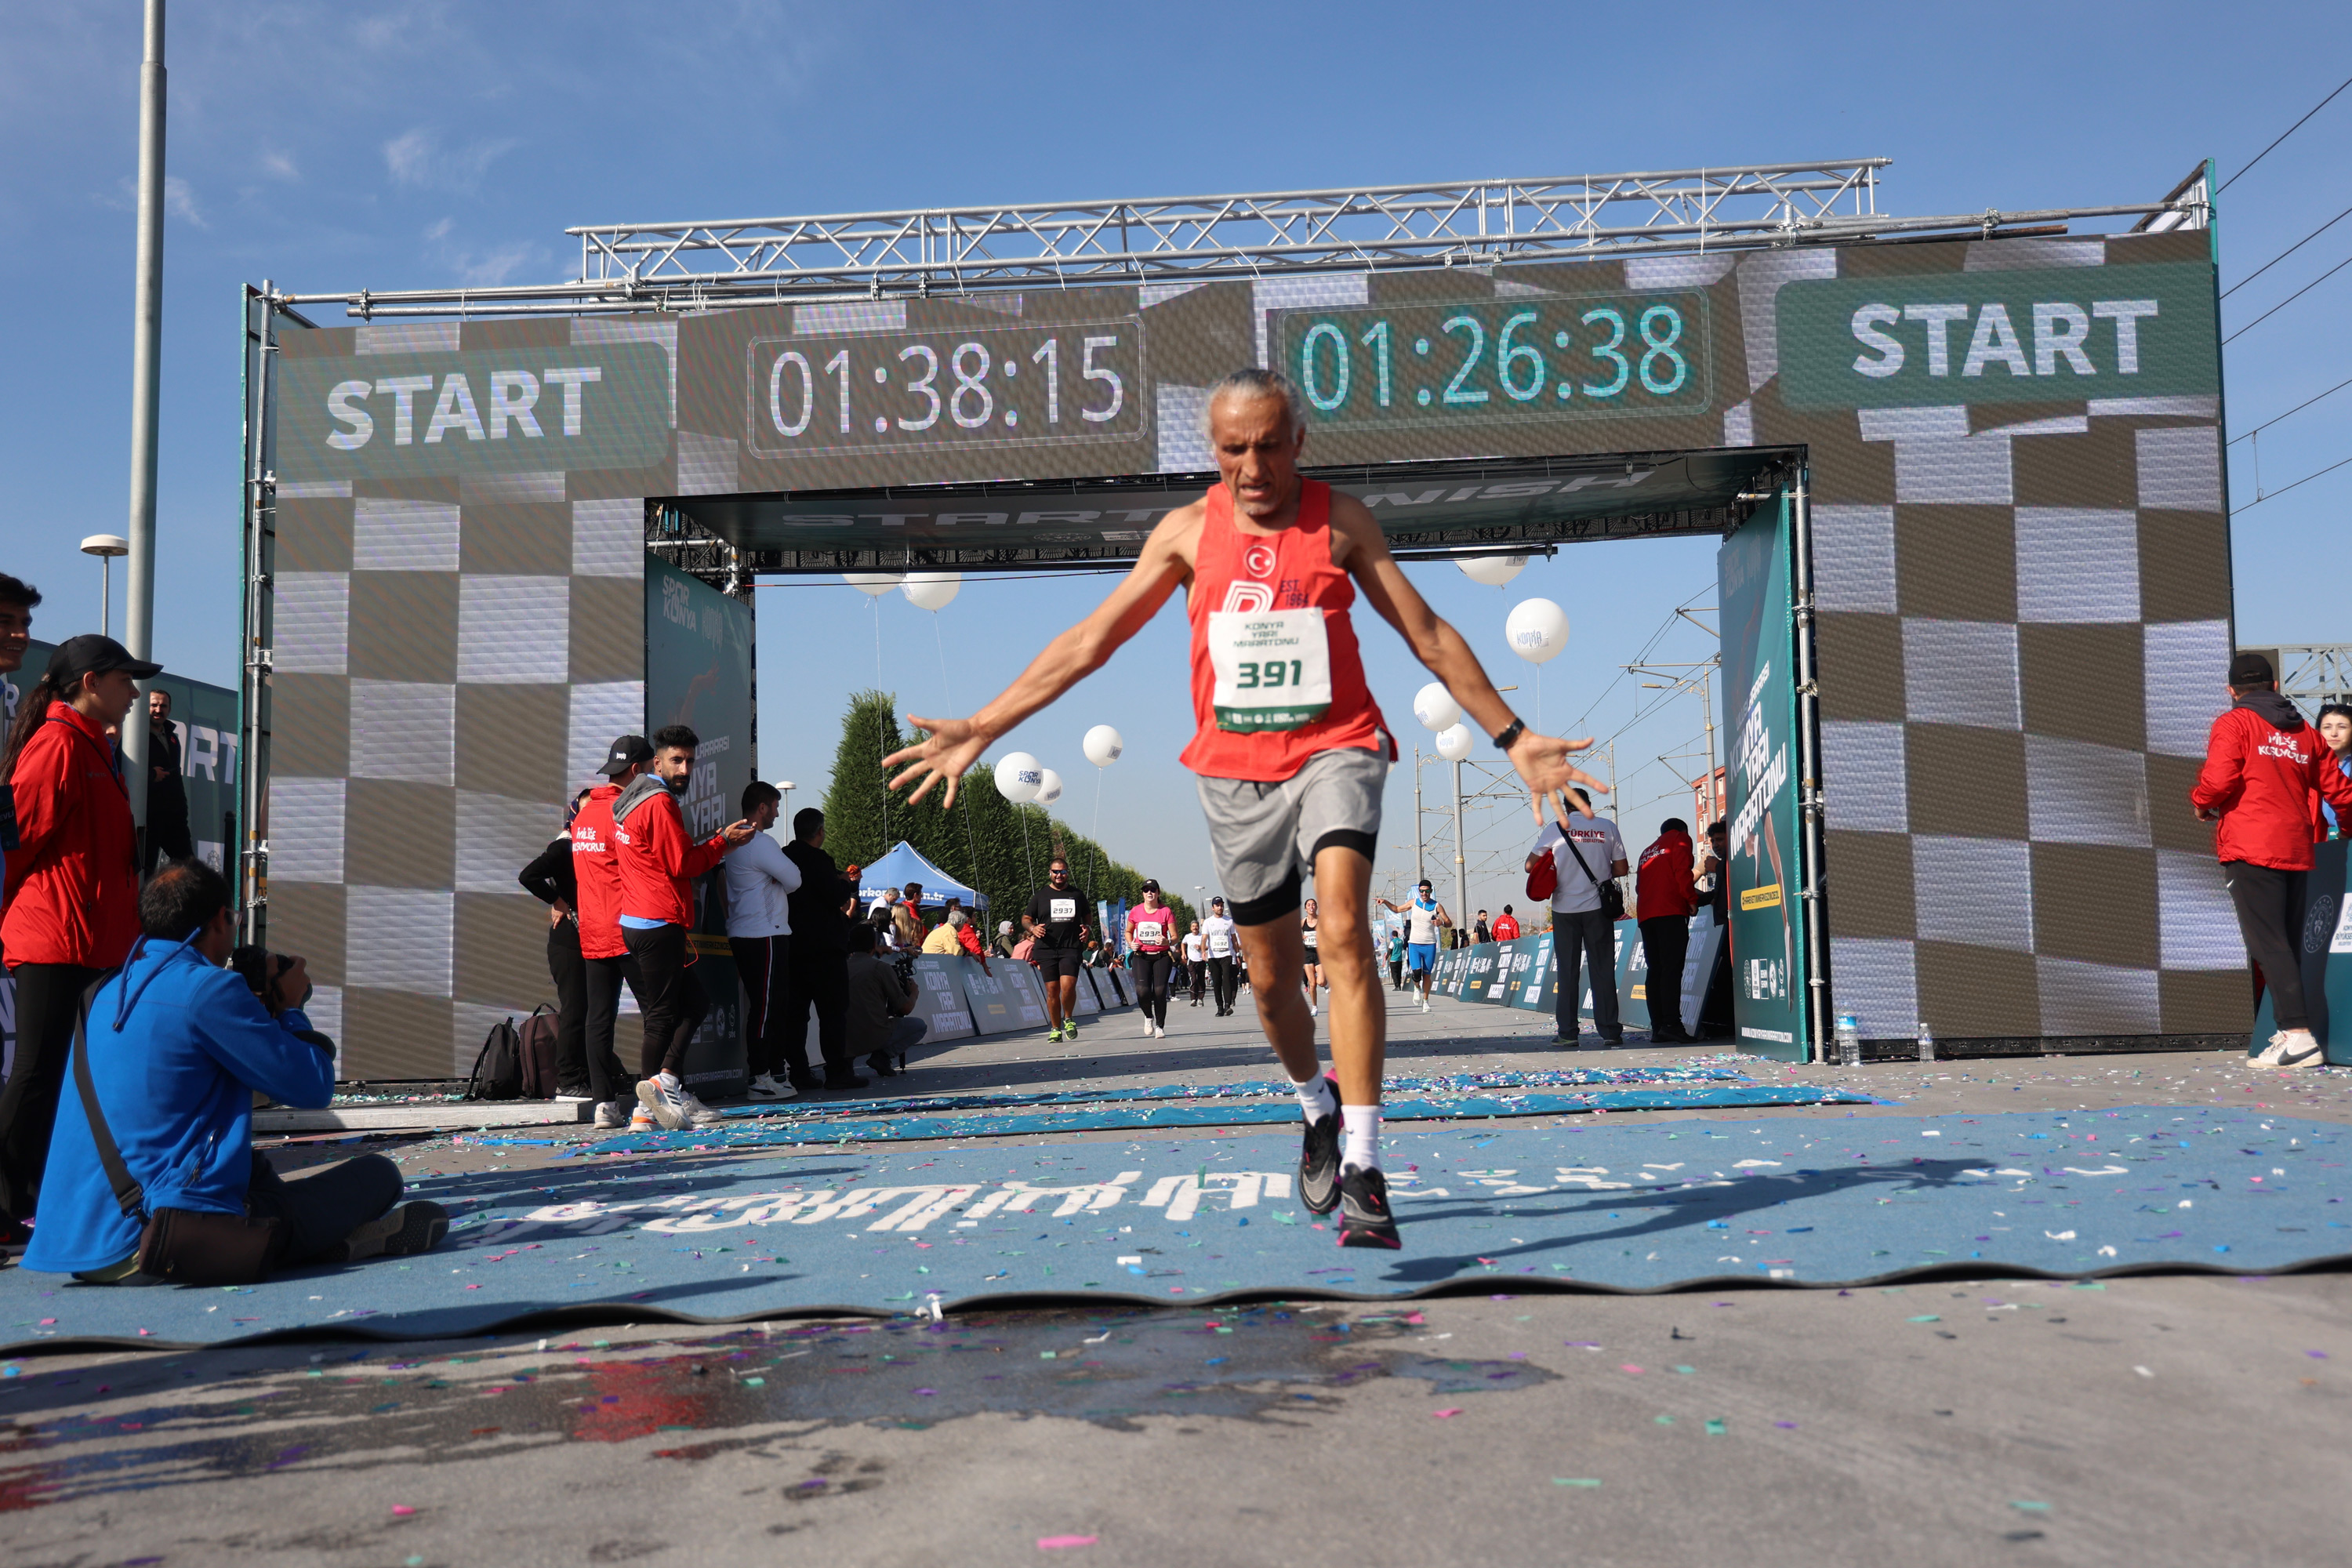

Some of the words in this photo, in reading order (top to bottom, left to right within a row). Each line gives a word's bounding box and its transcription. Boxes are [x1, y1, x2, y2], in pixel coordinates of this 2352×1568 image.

[1850, 299, 2158, 377] START
[1300, 306, 1686, 411] 01:26:38
[768, 335, 1124, 437] 01:38:15
[325, 365, 602, 451] START
[1361, 471, 1656, 507] NISH
[662, 575, 690, 606] SPOR
[663, 593, 696, 632] KONYA
[1245, 621, 1284, 630] KONYA
[1233, 637, 1299, 648] MARATONU
[1237, 660, 1301, 688] 391
[695, 735, 730, 760] LARARASI
[1730, 700, 1762, 784] KONYA
[1745, 727, 1769, 793] YARI
[679, 761, 717, 808] NYA
[1018, 775, 1041, 785] KONYA
[690, 793, 726, 837] YARI
[1730, 742, 1787, 861] MARATONU
[1566, 829, 1606, 838] TÜRKİYE
[924, 971, 950, 991] KONYA
[936, 991, 956, 1011] YARI
[931, 1011, 973, 1033] MARATONU
